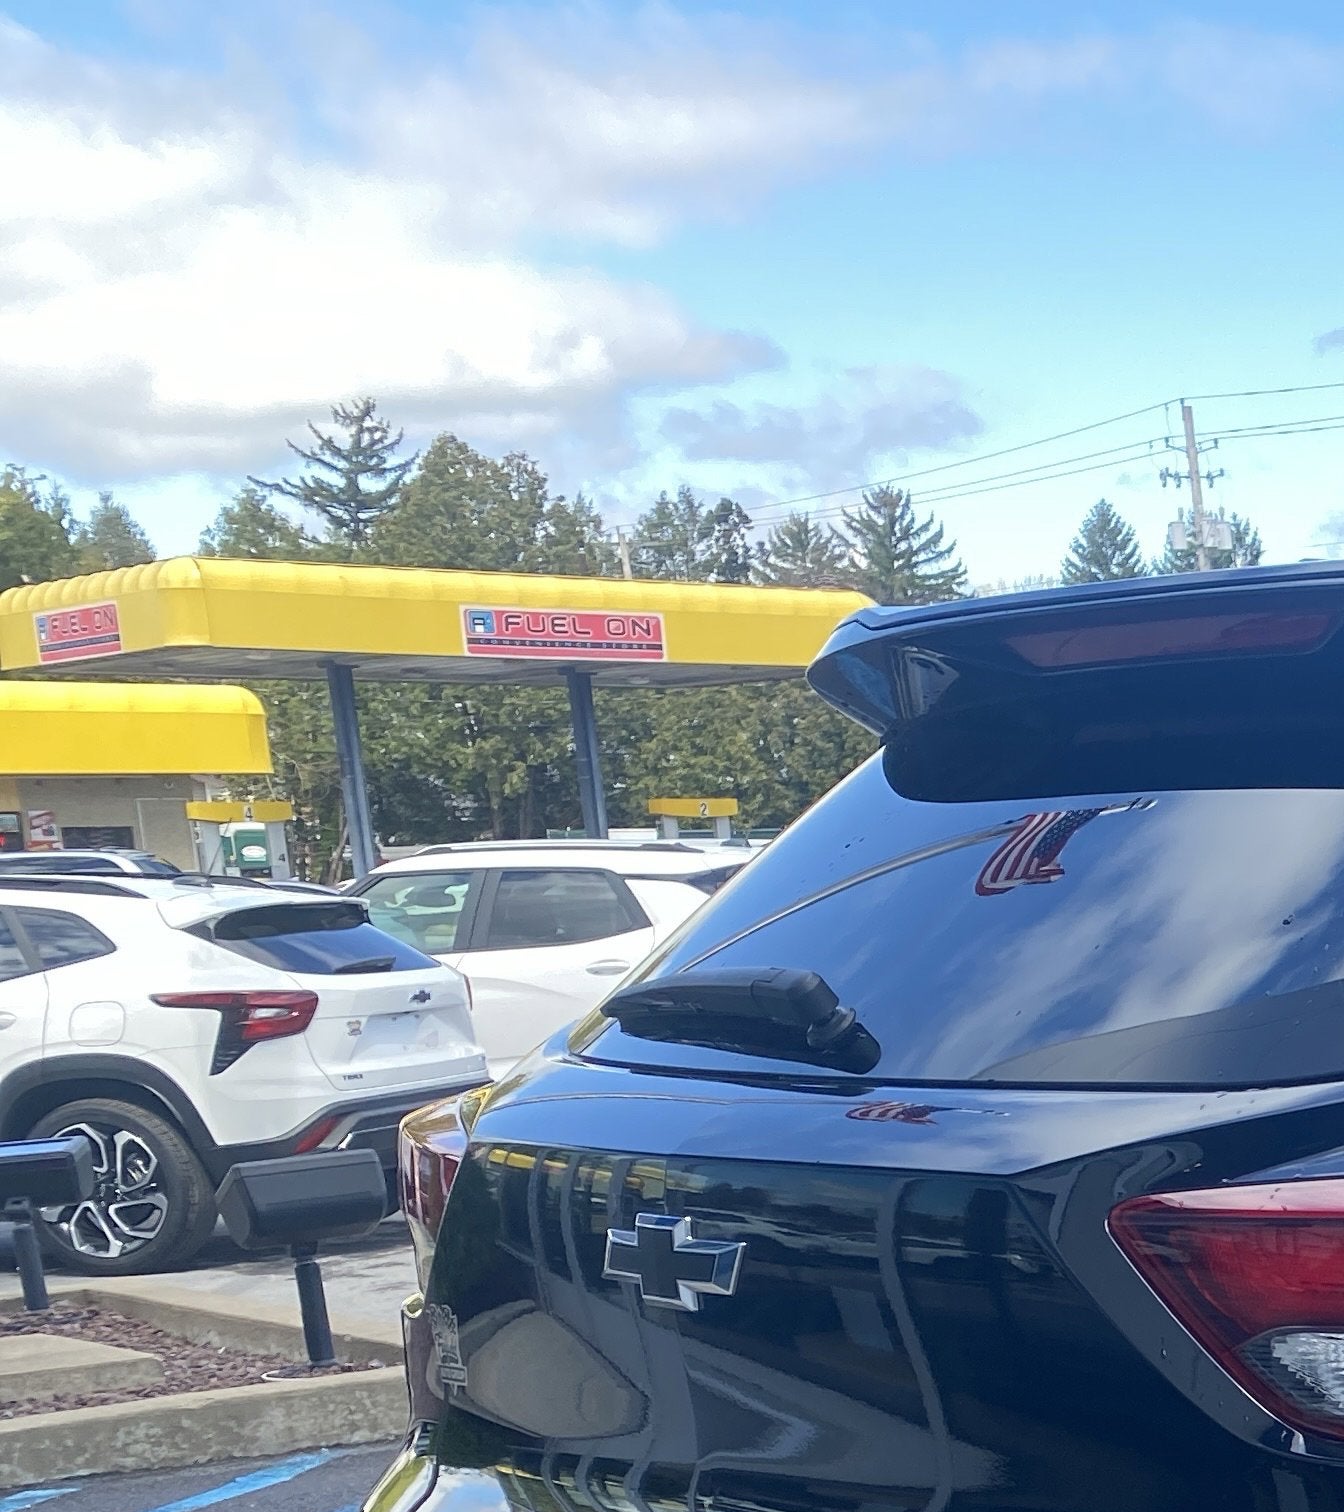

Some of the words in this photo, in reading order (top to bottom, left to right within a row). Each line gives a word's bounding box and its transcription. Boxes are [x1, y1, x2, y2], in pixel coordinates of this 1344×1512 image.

[51, 614, 89, 635] FUEL
[92, 608, 116, 630] ON
[503, 614, 592, 636] FUEL
[605, 617, 652, 637] ON
[479, 639, 593, 649] CONVENIENCE
[601, 641, 649, 650] STORE
[700, 802, 708, 816] 2
